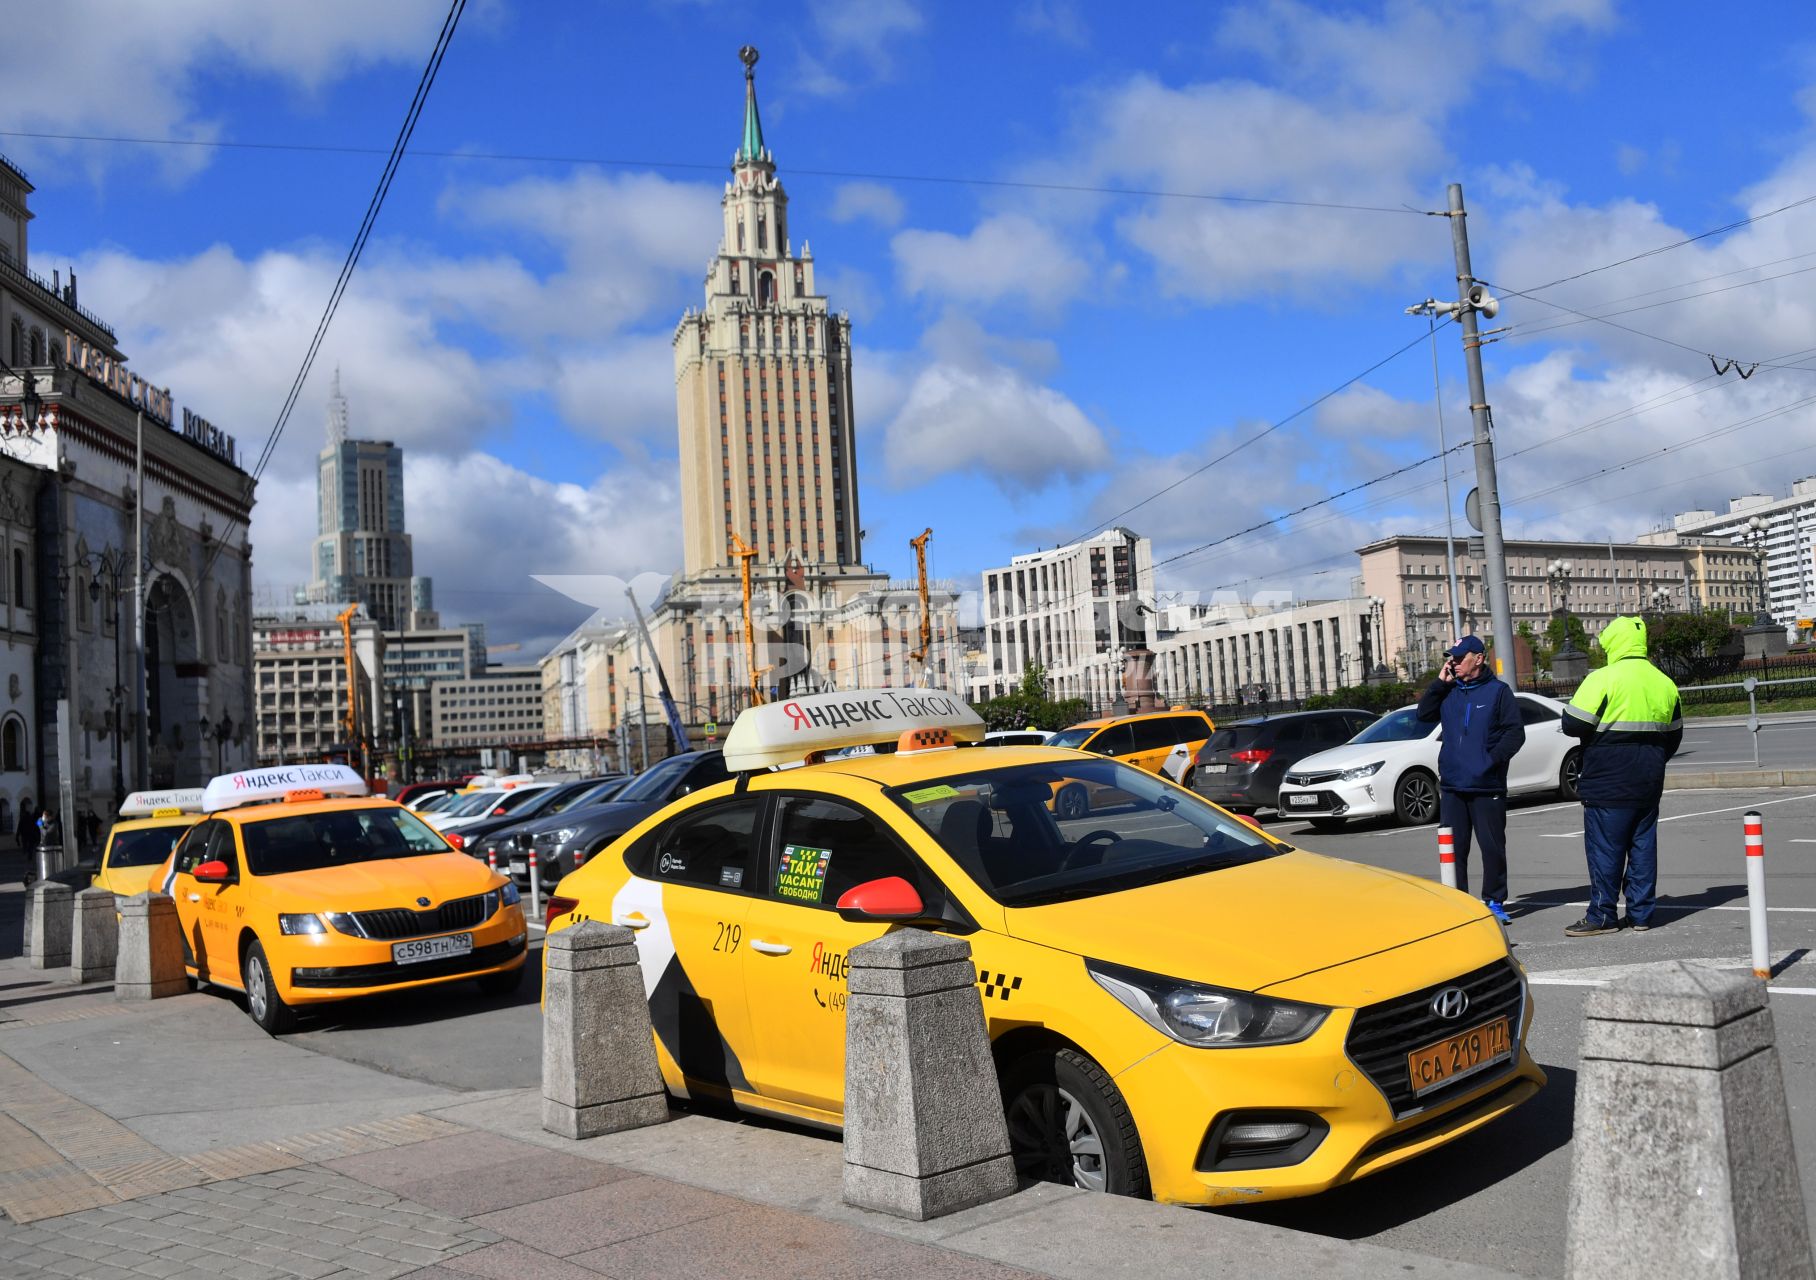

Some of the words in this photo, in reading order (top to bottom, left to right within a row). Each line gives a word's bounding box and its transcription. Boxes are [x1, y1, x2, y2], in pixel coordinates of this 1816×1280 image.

[65, 329, 174, 427] КАЗАНСКИЙ
[182, 406, 236, 465] ВОКЗАЛ
[783, 698, 893, 731] Яндекс
[881, 692, 961, 719] Такси
[232, 771, 296, 791] Яндекс
[299, 767, 344, 783] Такси
[135, 795, 171, 806] Яндекс
[174, 793, 203, 803] Такси
[789, 859, 818, 876] TAXI
[778, 886, 818, 900] СВОБОДНО
[780, 874, 822, 889] VACANT
[713, 921, 742, 954] 219
[810, 941, 849, 981] Янде
[828, 992, 846, 1012] (49
[1421, 1056, 1445, 1083] СА
[1450, 1034, 1482, 1073] 219
[1488, 1022, 1505, 1048] 77
